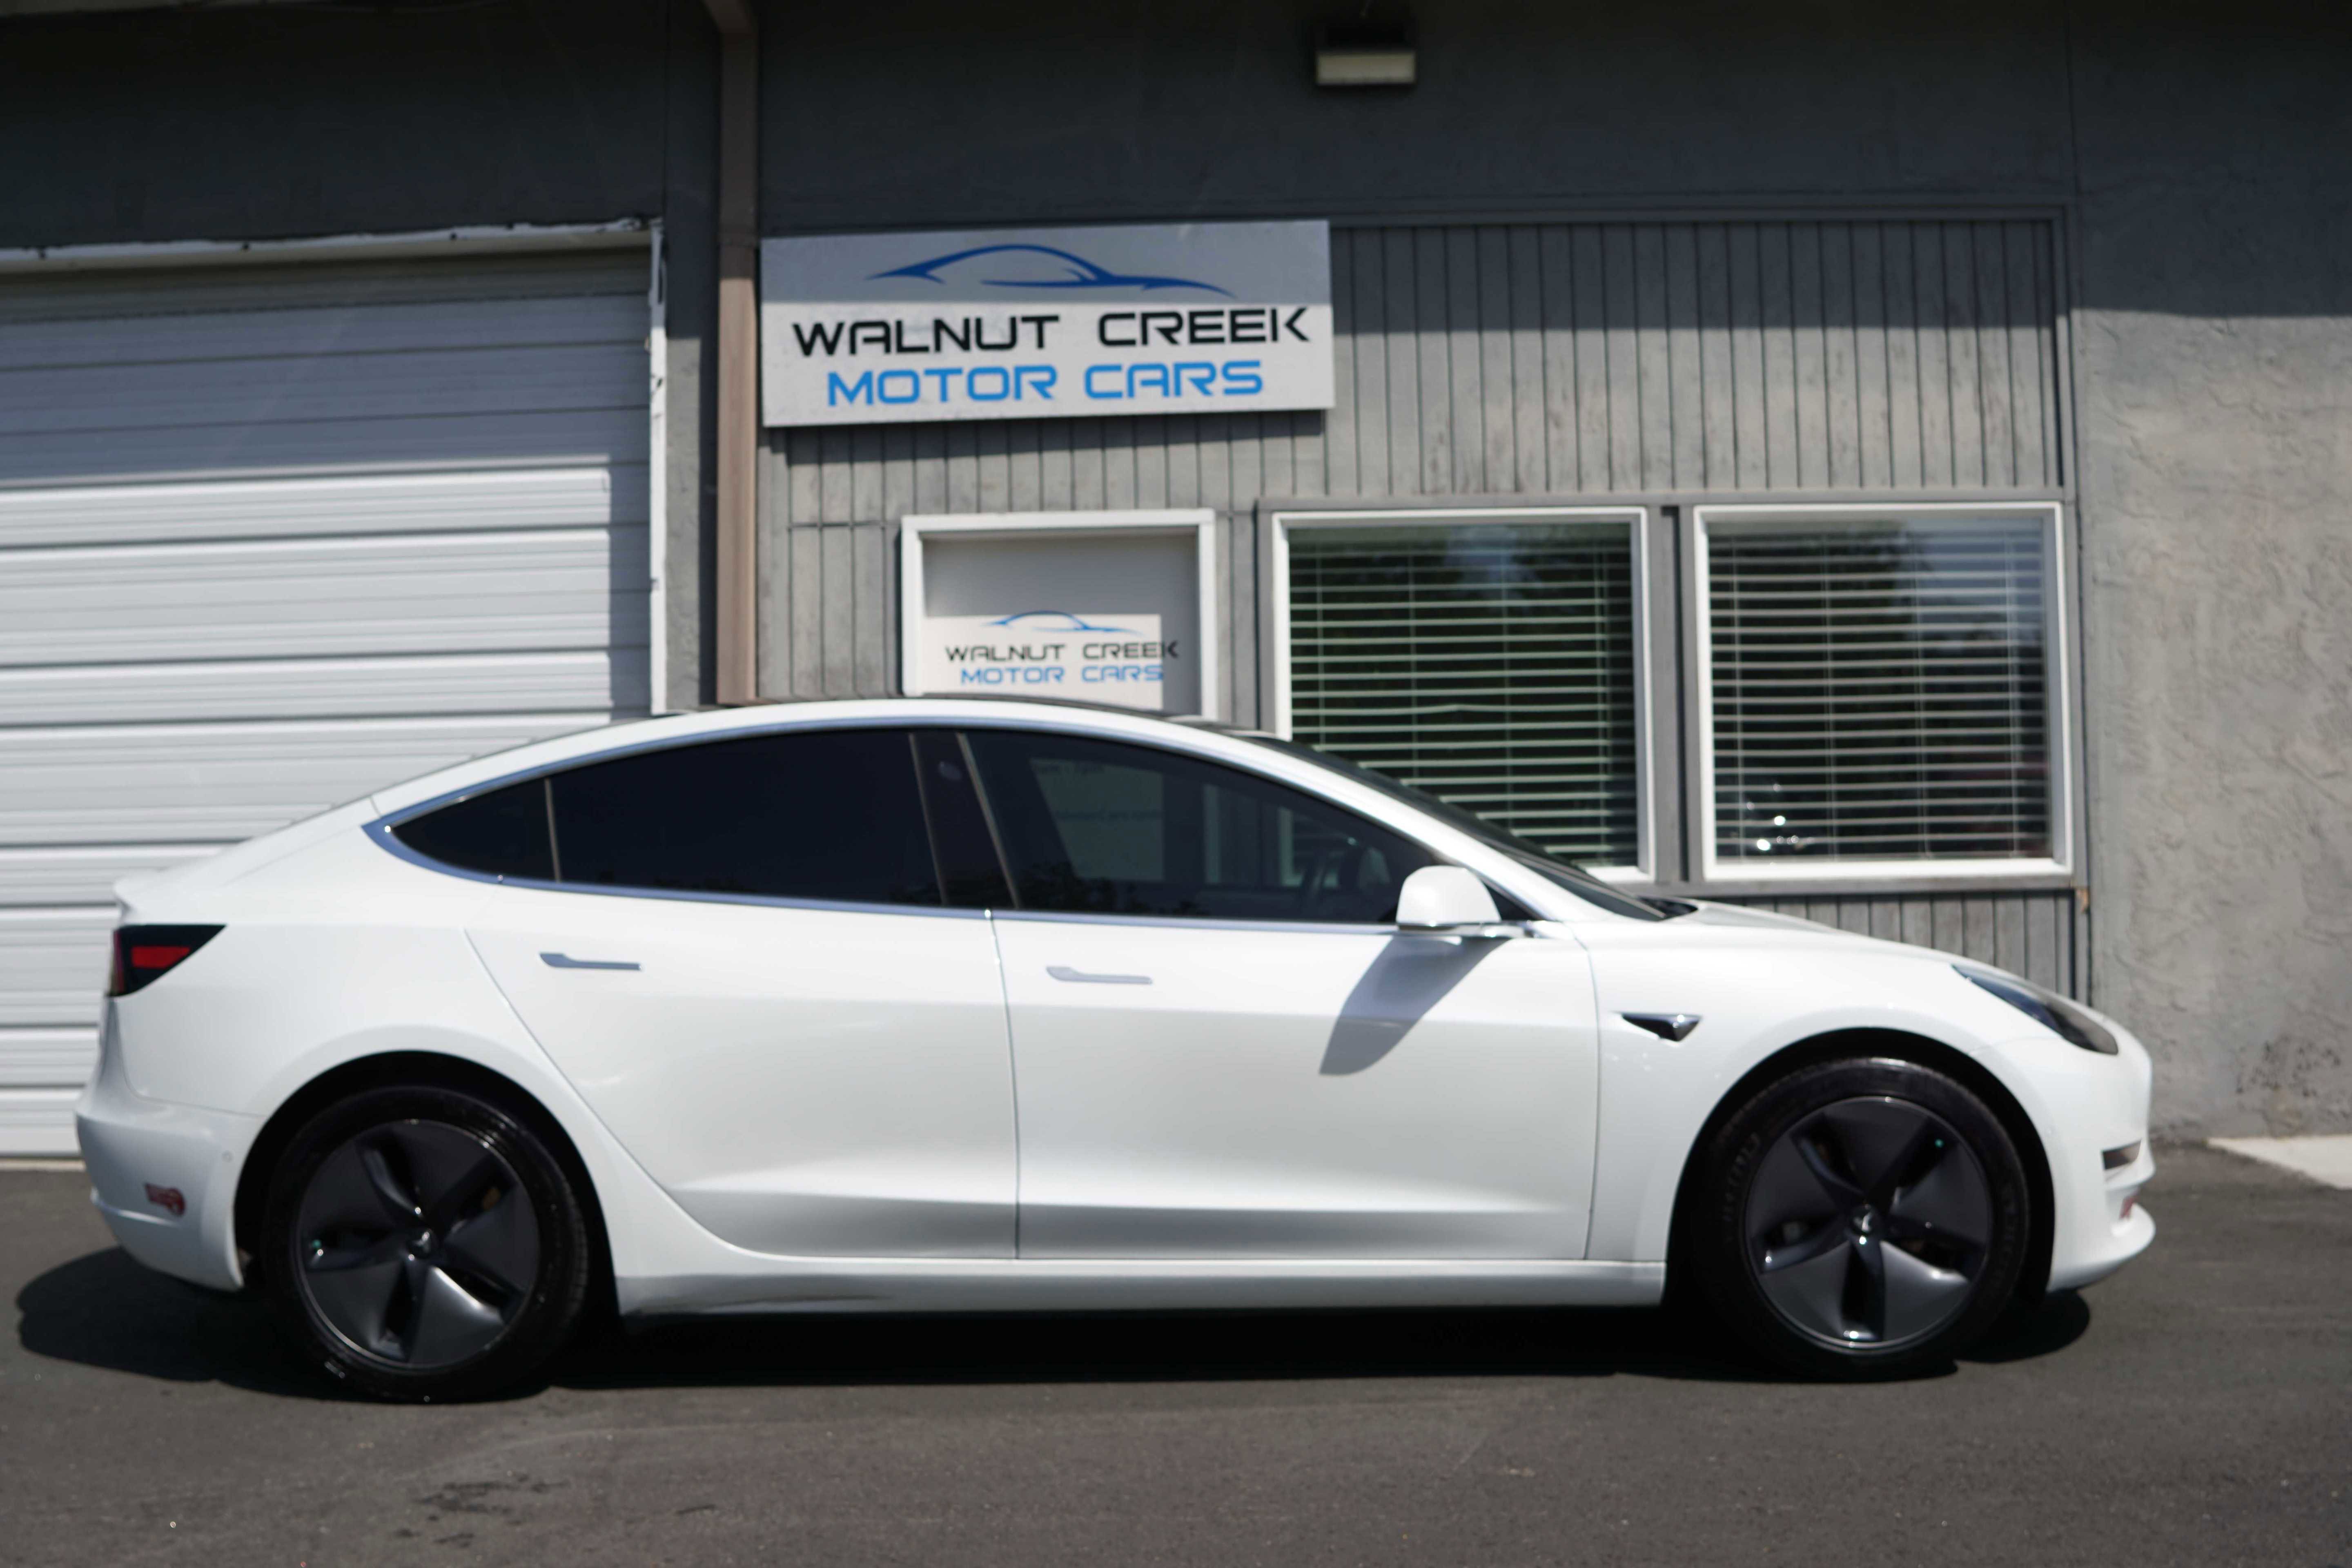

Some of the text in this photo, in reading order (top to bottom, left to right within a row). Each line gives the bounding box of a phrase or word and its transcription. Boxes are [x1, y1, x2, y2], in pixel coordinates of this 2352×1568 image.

[792, 307, 1309, 357] WALNUT CREEK
[828, 360, 1263, 406] MOTOR CARS
[946, 640, 1179, 662] WALNUT CREEK
[961, 664, 1165, 684] MOTOR CARS
